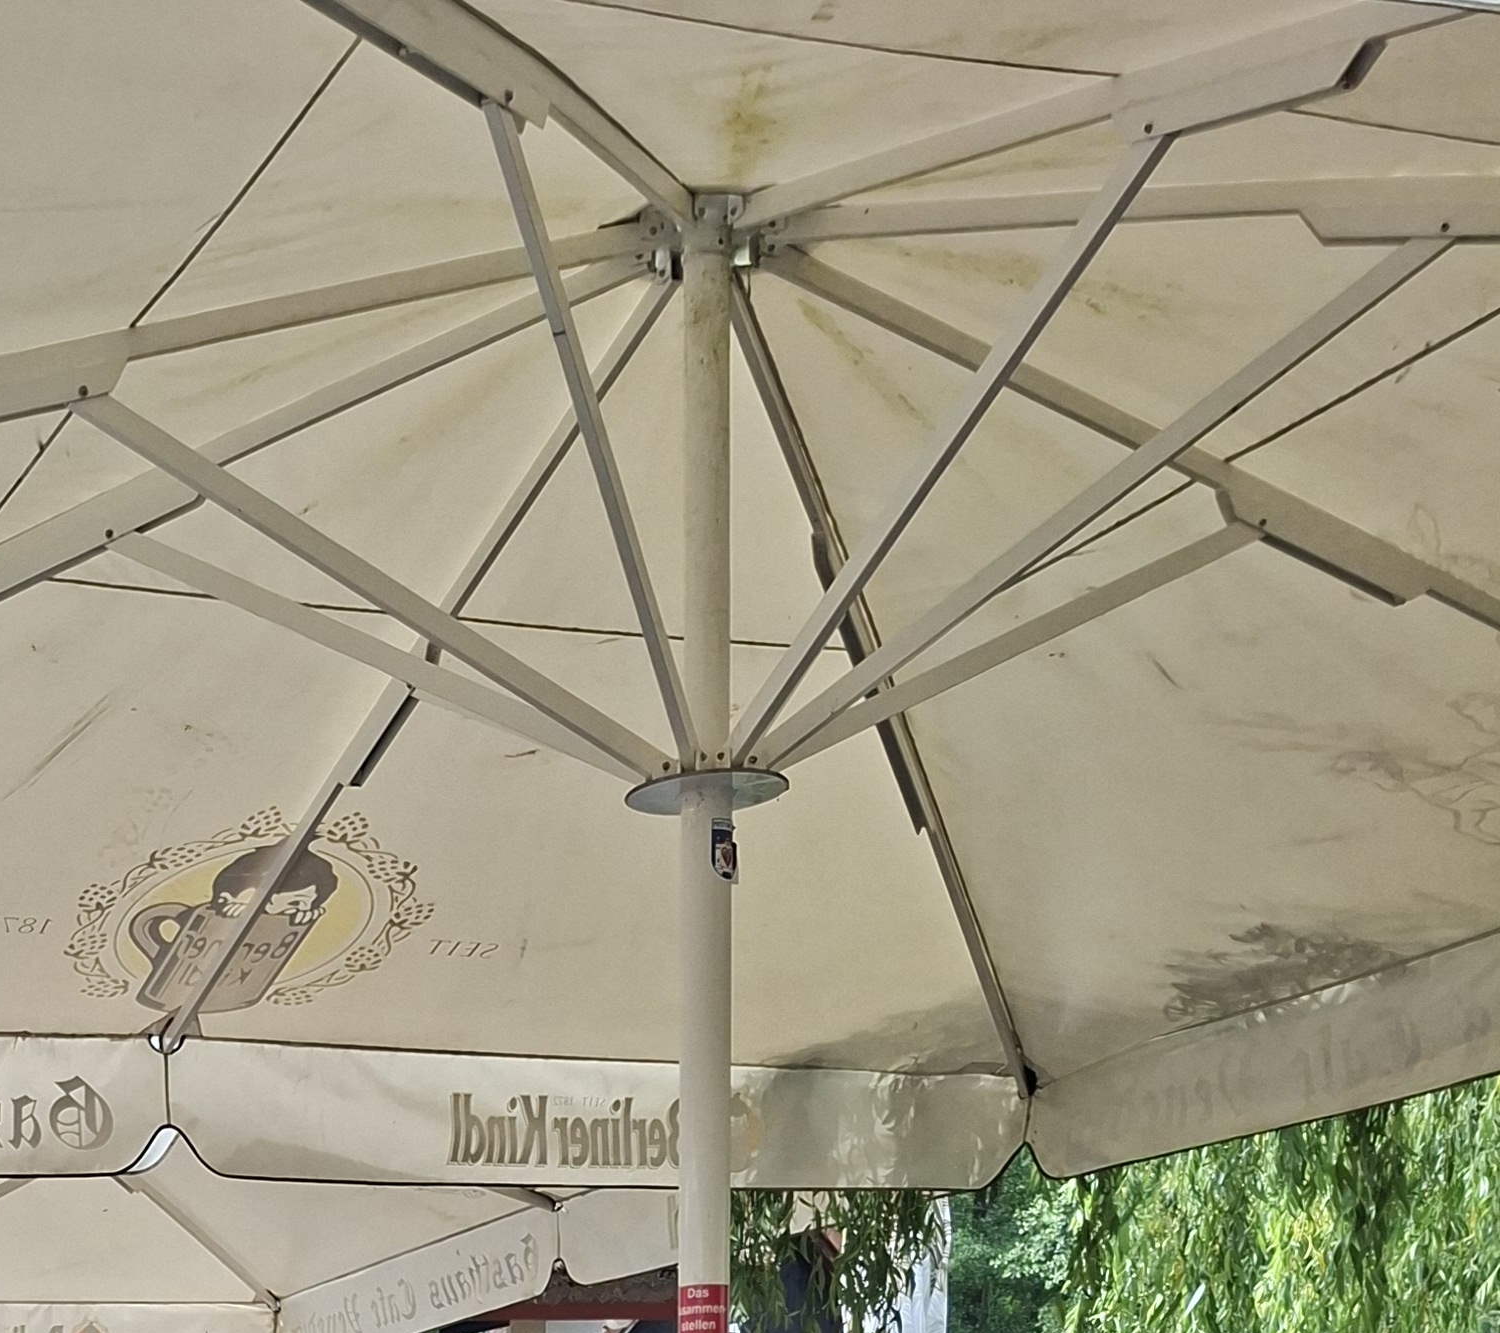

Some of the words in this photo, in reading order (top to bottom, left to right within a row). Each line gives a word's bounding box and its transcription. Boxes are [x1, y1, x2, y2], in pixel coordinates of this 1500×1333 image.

[687, 1287, 710, 1299] Das
[678, 1303, 727, 1317] sammen-
[681, 1319, 717, 1332] stellen
